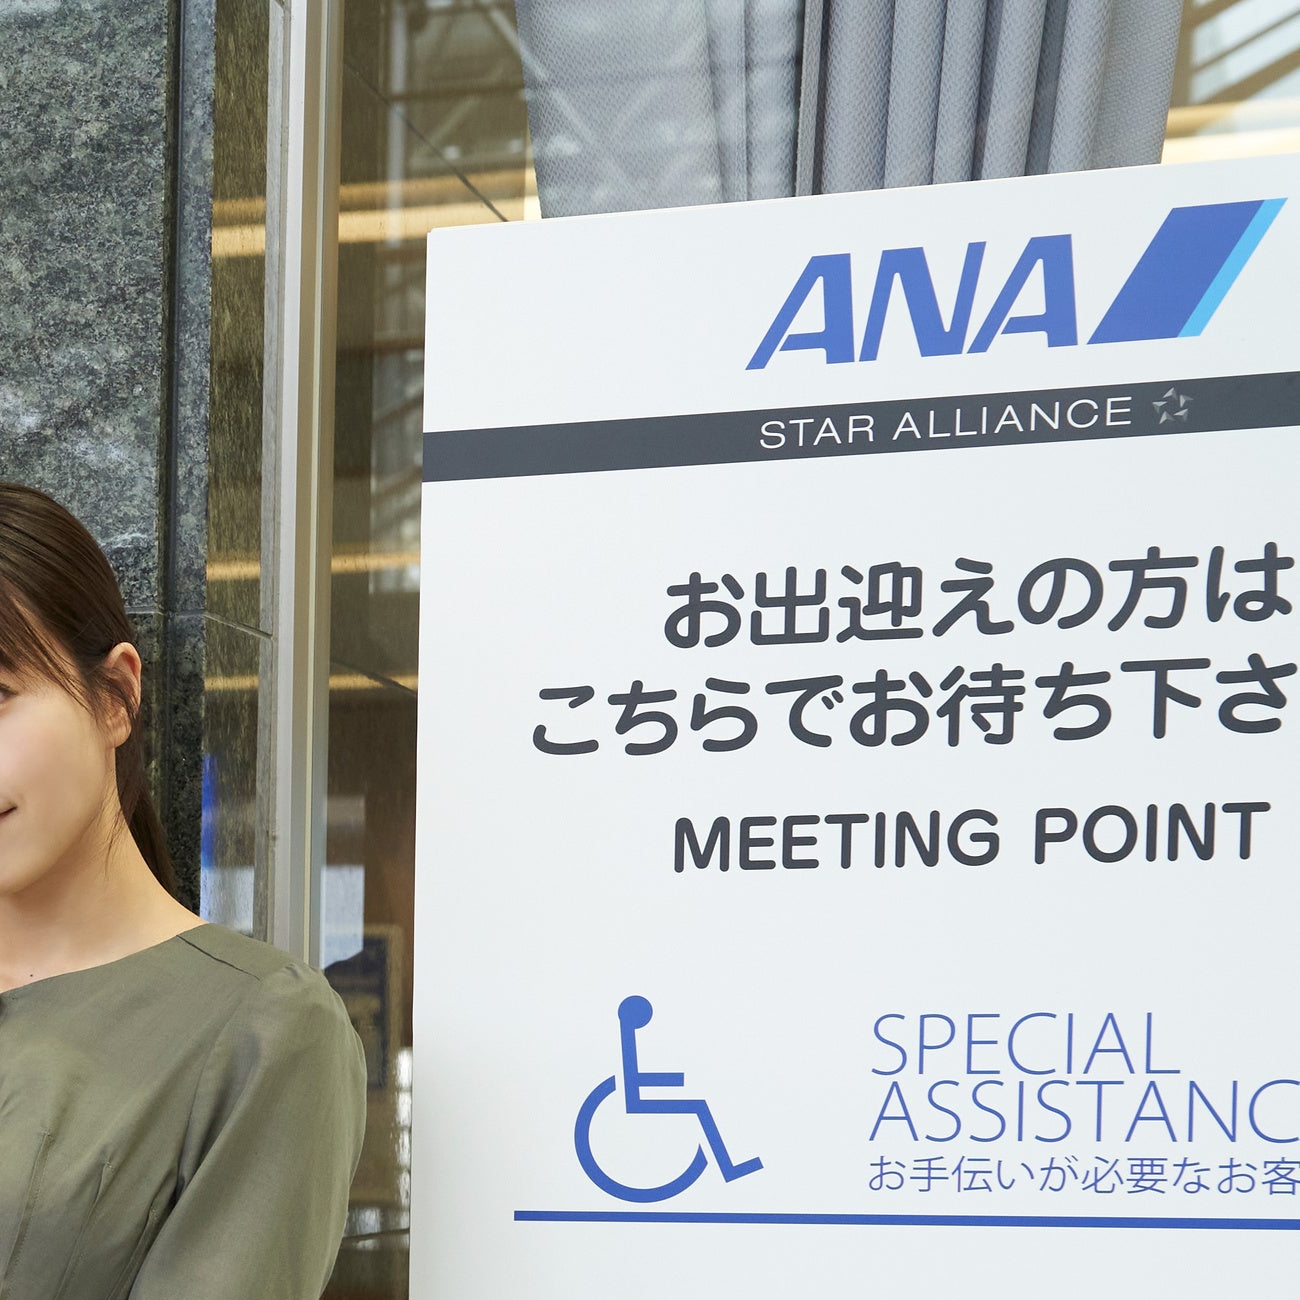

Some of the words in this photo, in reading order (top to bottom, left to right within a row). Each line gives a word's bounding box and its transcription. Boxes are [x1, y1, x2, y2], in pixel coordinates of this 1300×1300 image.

[745, 234, 1079, 370] ANA
[759, 411, 875, 449] STAR
[892, 396, 1134, 440] ALLIANCE
[664, 541, 1296, 648] お出迎えの方は
[532, 652, 1299, 756] こちらでお待ち下さ
[673, 808, 1000, 873] MEETING
[1034, 801, 1272, 864] POINT
[871, 1012, 1181, 1076] SPECIAL
[868, 1079, 1300, 1144] ASSISTANC
[868, 1156, 1300, 1196] お手伝いが必要なお客
